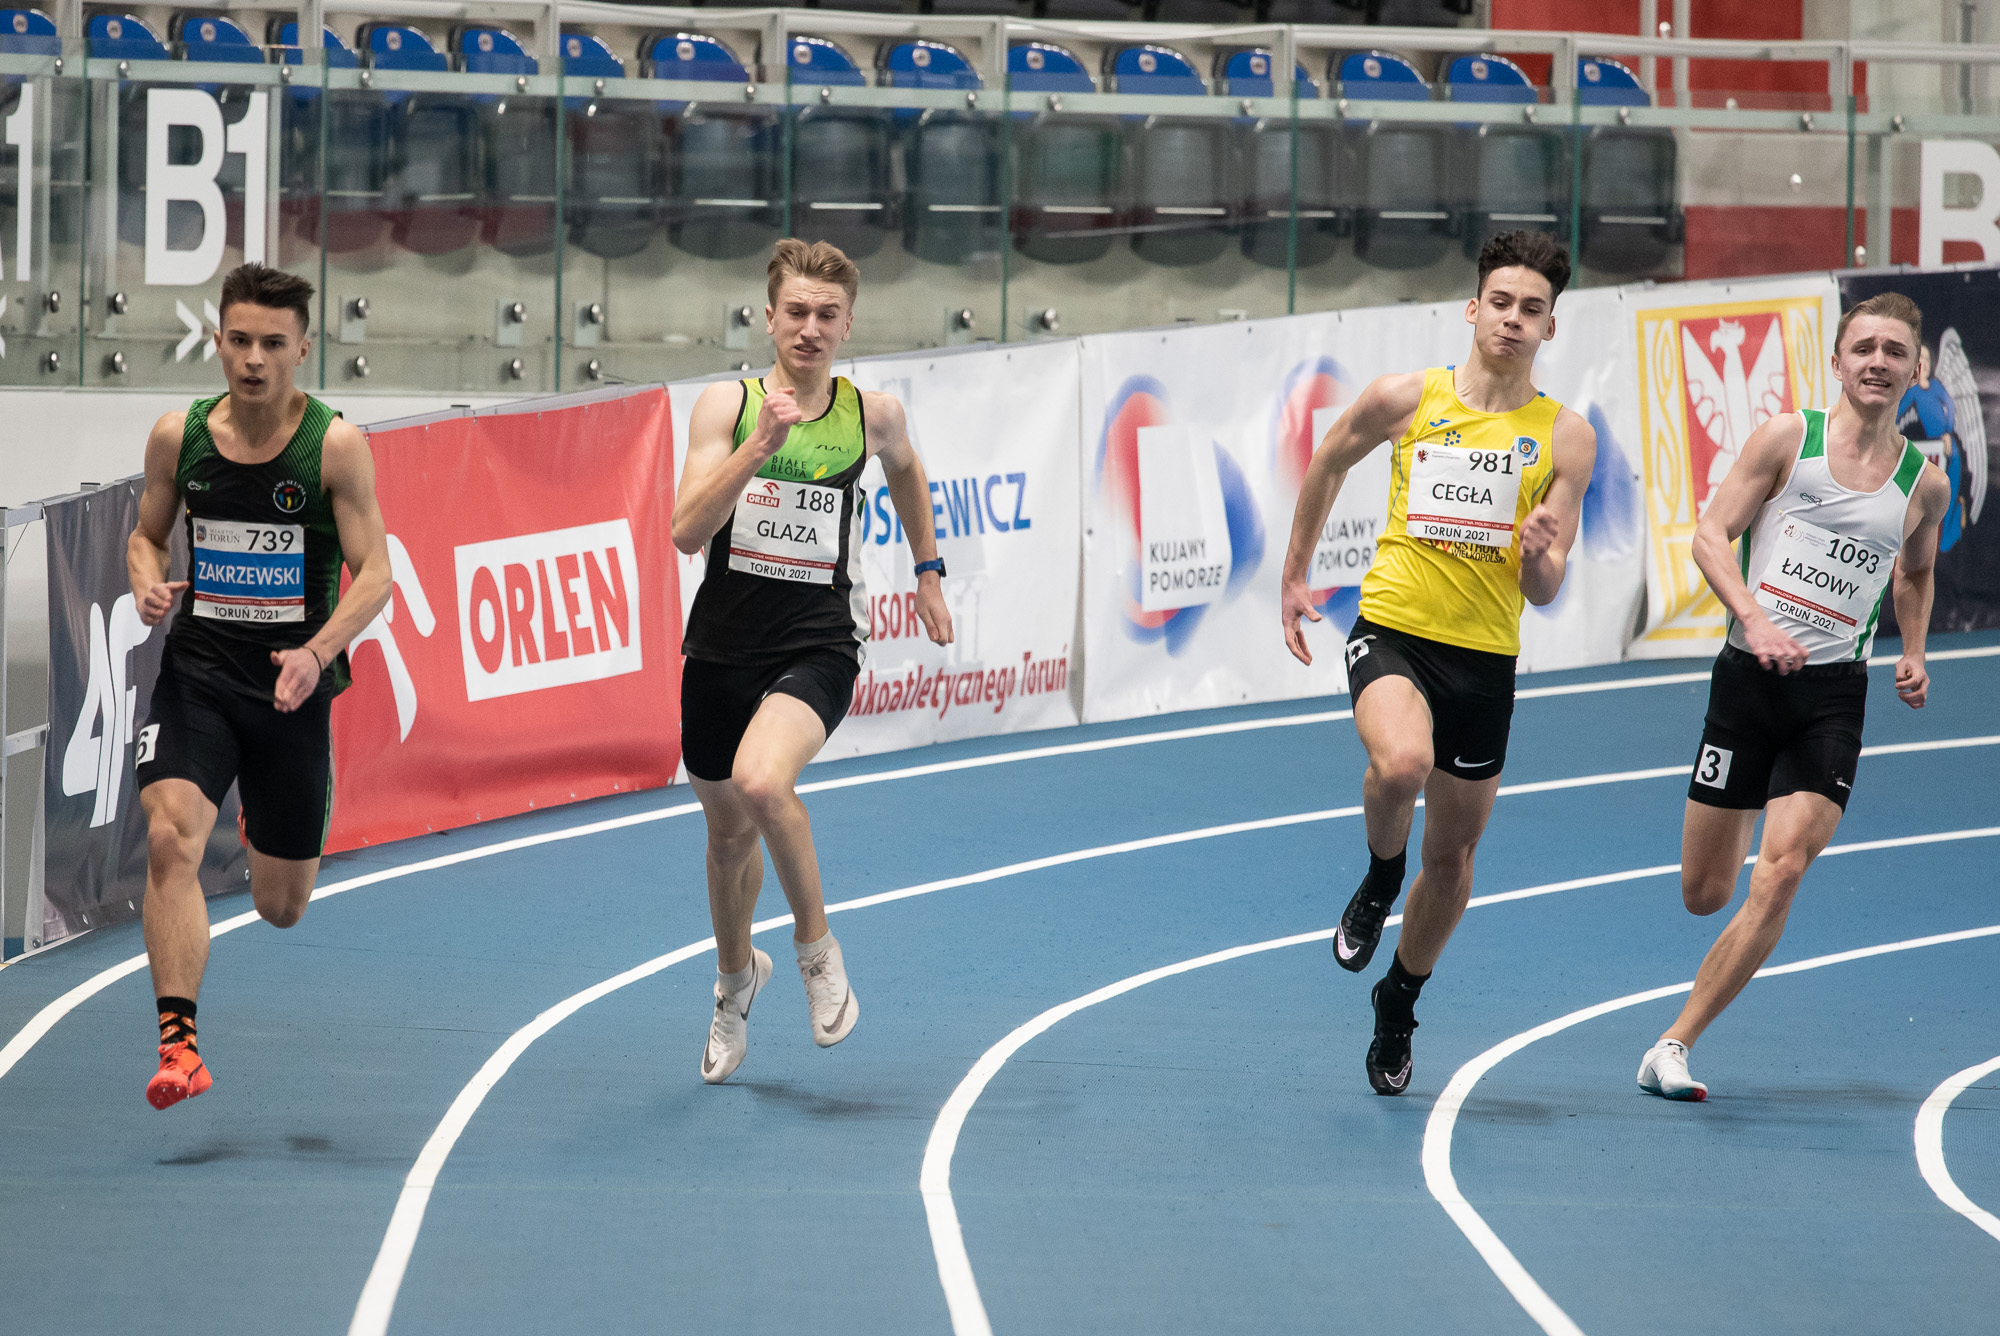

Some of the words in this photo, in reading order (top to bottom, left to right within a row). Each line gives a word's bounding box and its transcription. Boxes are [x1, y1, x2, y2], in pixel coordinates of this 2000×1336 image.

[145, 88, 268, 285] B1
[770, 464, 807, 479] BŁOTA
[772, 455, 807, 470] BIAŁE
[1469, 450, 1513, 475] 981
[748, 494, 778, 507] ORLEN
[795, 488, 835, 514] 188
[1432, 483, 1493, 506] CEGŁA
[209, 532, 240, 544] TORUŃ
[245, 528, 295, 552] 739
[756, 520, 818, 545] GLAZA
[1424, 525, 1462, 538] TORUŃ
[1464, 530, 1490, 542] 2021
[1149, 539, 1207, 563] KUJAWY
[1451, 548, 1507, 565] WIELKOPOLSKI
[1826, 538, 1880, 575] 1093
[198, 561, 300, 586] ZAKRZEWSKI
[750, 561, 786, 578] TORUŃ
[788, 568, 812, 581] 2021
[1150, 564, 1223, 593] POMORZE
[1781, 558, 1860, 600] ŁAZOWY
[214, 606, 250, 619] TORUŃ
[254, 609, 279, 620] 2021
[470, 547, 630, 674] ORLEN
[1775, 600, 1811, 621] TORUŃ
[1811, 614, 1836, 632] 2021
[1020, 643, 1067, 697] Toruń
[137, 730, 150, 762] 6
[1701, 749, 1722, 783] 3
